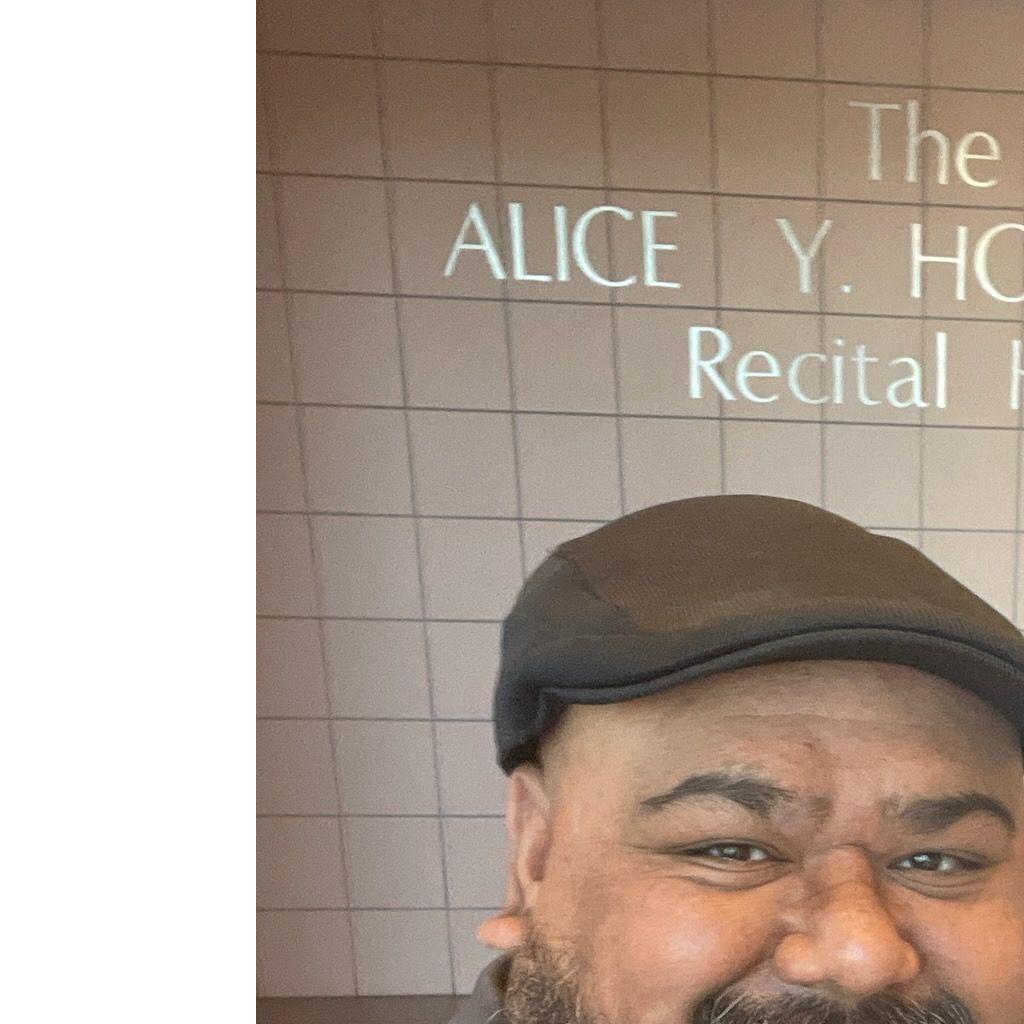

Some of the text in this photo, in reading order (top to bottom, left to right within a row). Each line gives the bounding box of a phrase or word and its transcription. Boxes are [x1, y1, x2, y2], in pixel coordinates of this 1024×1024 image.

[848, 100, 1001, 188] The
[444, 202, 682, 289] ALICE
[776, 218, 854, 294] Y.
[687, 326, 949, 410] Recital
